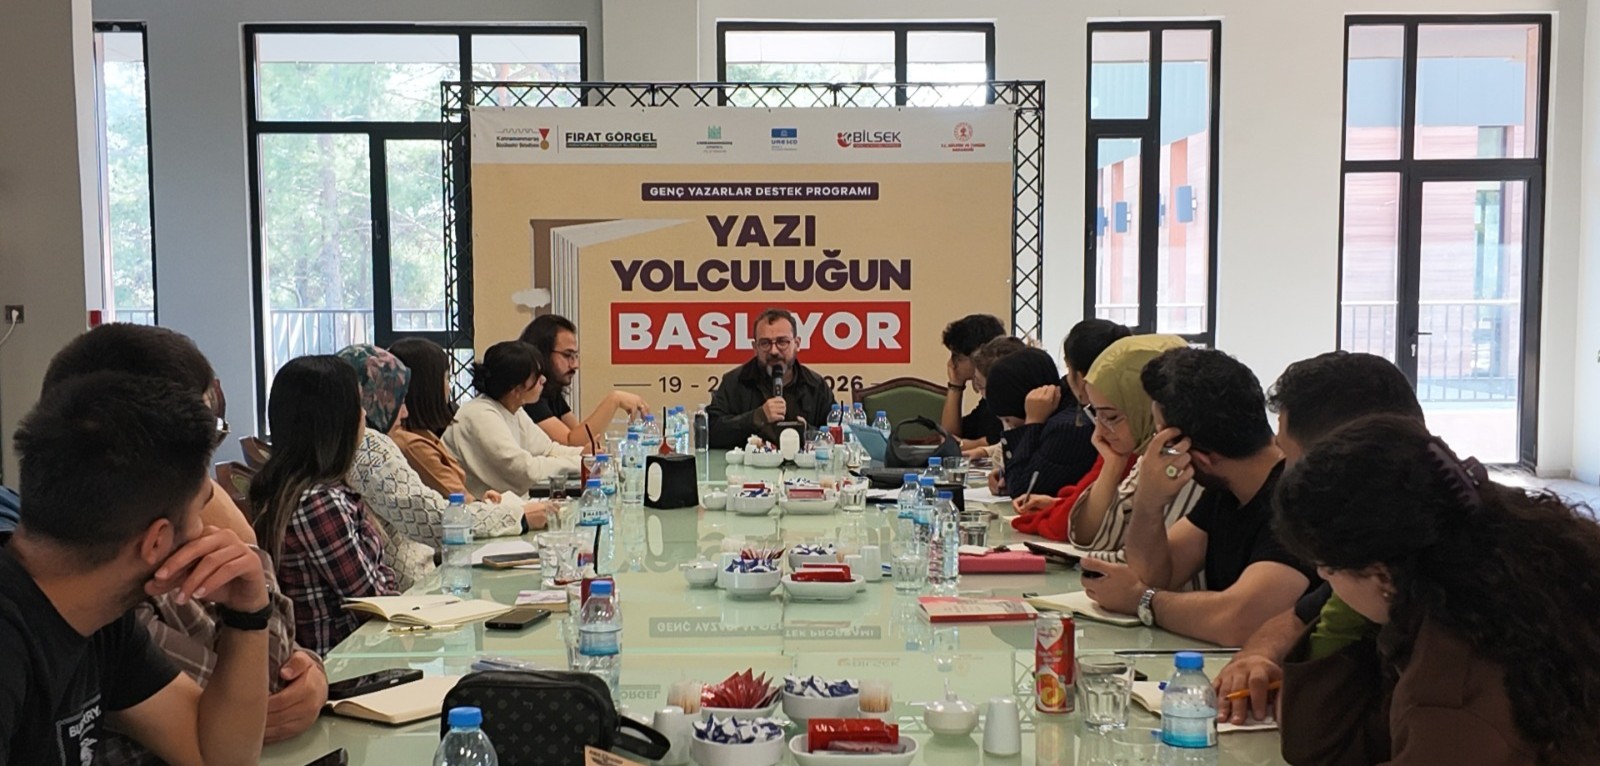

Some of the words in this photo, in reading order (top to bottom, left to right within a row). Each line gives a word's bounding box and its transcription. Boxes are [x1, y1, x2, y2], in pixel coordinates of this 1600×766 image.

[565, 132, 601, 142] FIRAT
[605, 131, 657, 142] GÖRGEL
[853, 129, 901, 143] BİLSEK
[649, 187, 685, 198] GENÇ
[688, 187, 752, 196] YAZARLAR
[756, 187, 802, 196] DESTEK
[806, 187, 871, 196] PROGRAMI
[706, 215, 816, 247] YAZI
[610, 249, 911, 292] YOLCULUĞUN
[618, 311, 902, 358] BAŞLYOR
[659, 376, 682, 393] 19
[823, 375, 863, 391] 026
